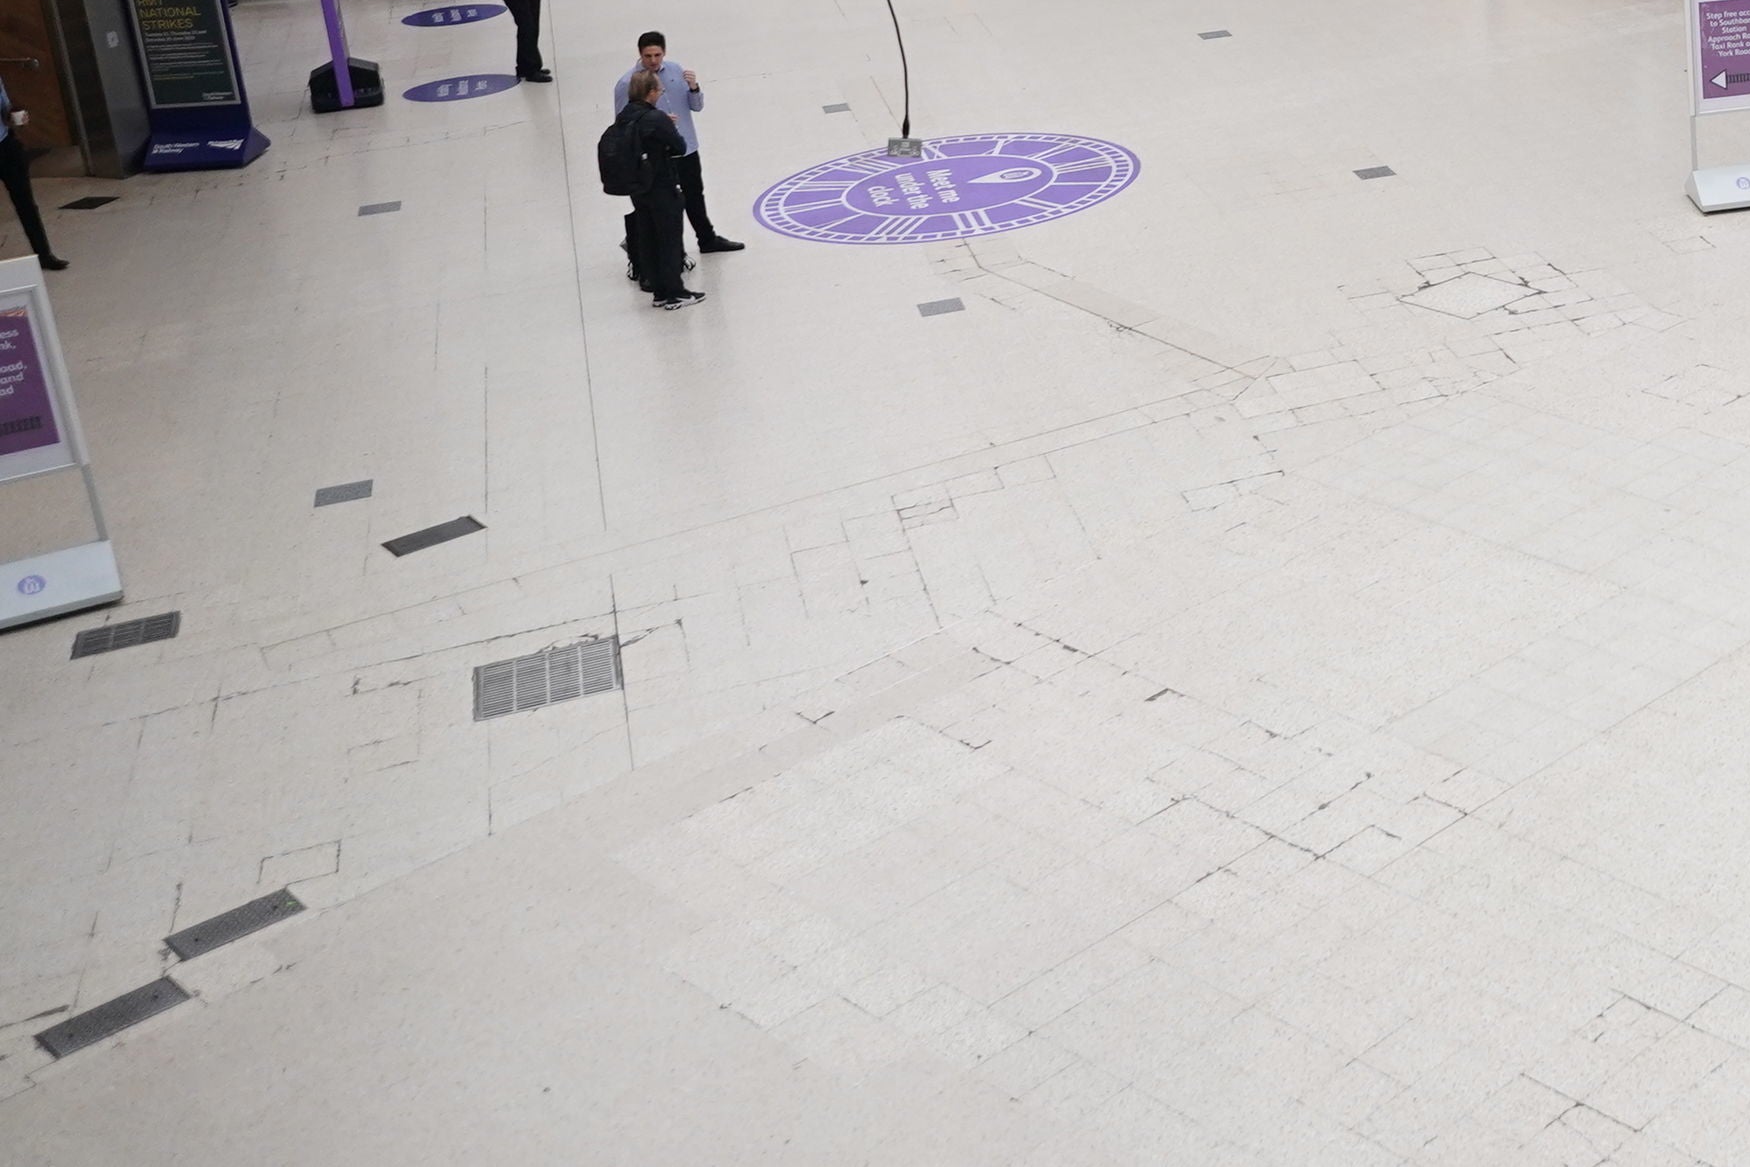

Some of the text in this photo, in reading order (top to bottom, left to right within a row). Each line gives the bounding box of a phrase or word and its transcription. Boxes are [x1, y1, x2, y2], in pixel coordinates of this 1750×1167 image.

[140, 6, 201, 18] NATIONAL
[143, 18, 194, 31] STRIKES
[1722, 25, 1747, 33] Station
[1708, 33, 1741, 43] Approach
[1727, 41, 1744, 49] Rank
[1718, 49, 1733, 57] York
[895, 173, 933, 209] under the
[927, 169, 960, 203] Meet me
[868, 186, 900, 207] clock
[0, 360, 28, 373] oad,
